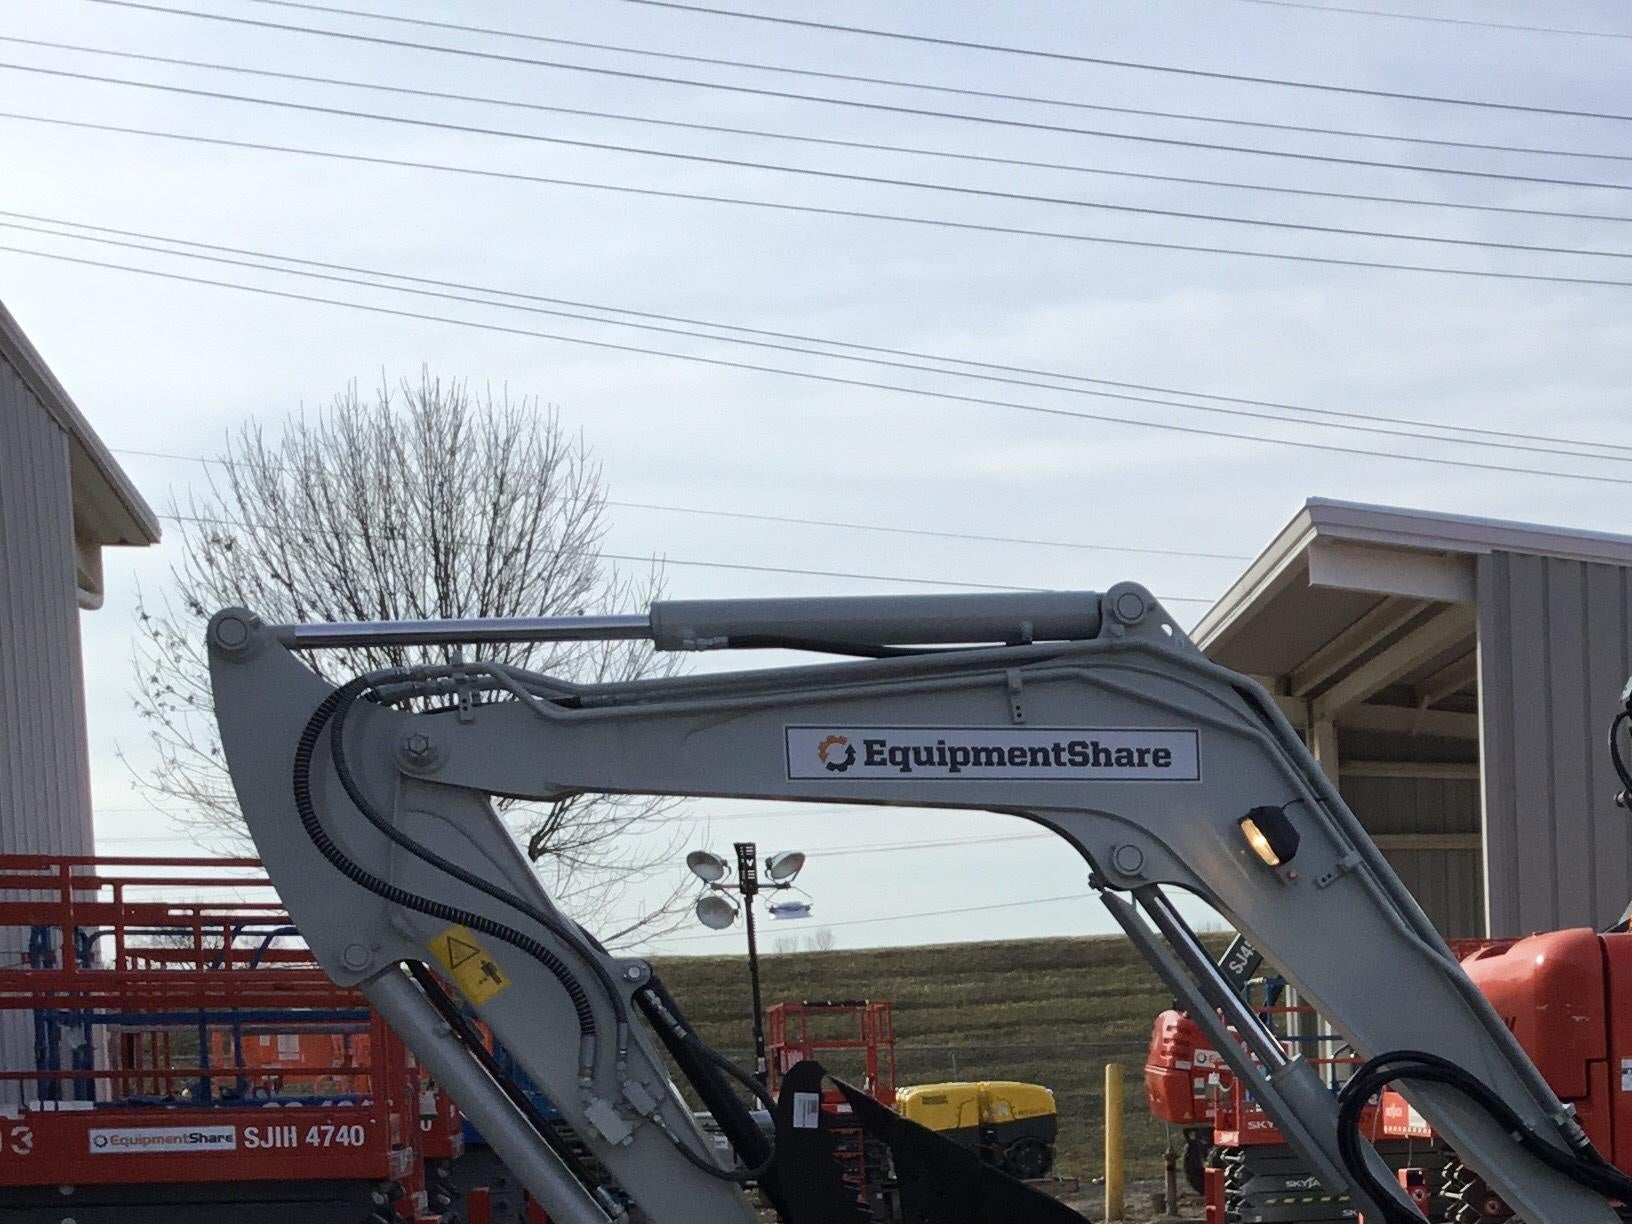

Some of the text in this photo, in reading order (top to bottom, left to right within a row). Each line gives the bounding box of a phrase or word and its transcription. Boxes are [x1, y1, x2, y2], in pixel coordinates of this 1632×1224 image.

[863, 739, 1172, 773] EquipmentShare
[109, 1131, 234, 1146] EquipmentShare
[305, 1125, 365, 1147] 4740
